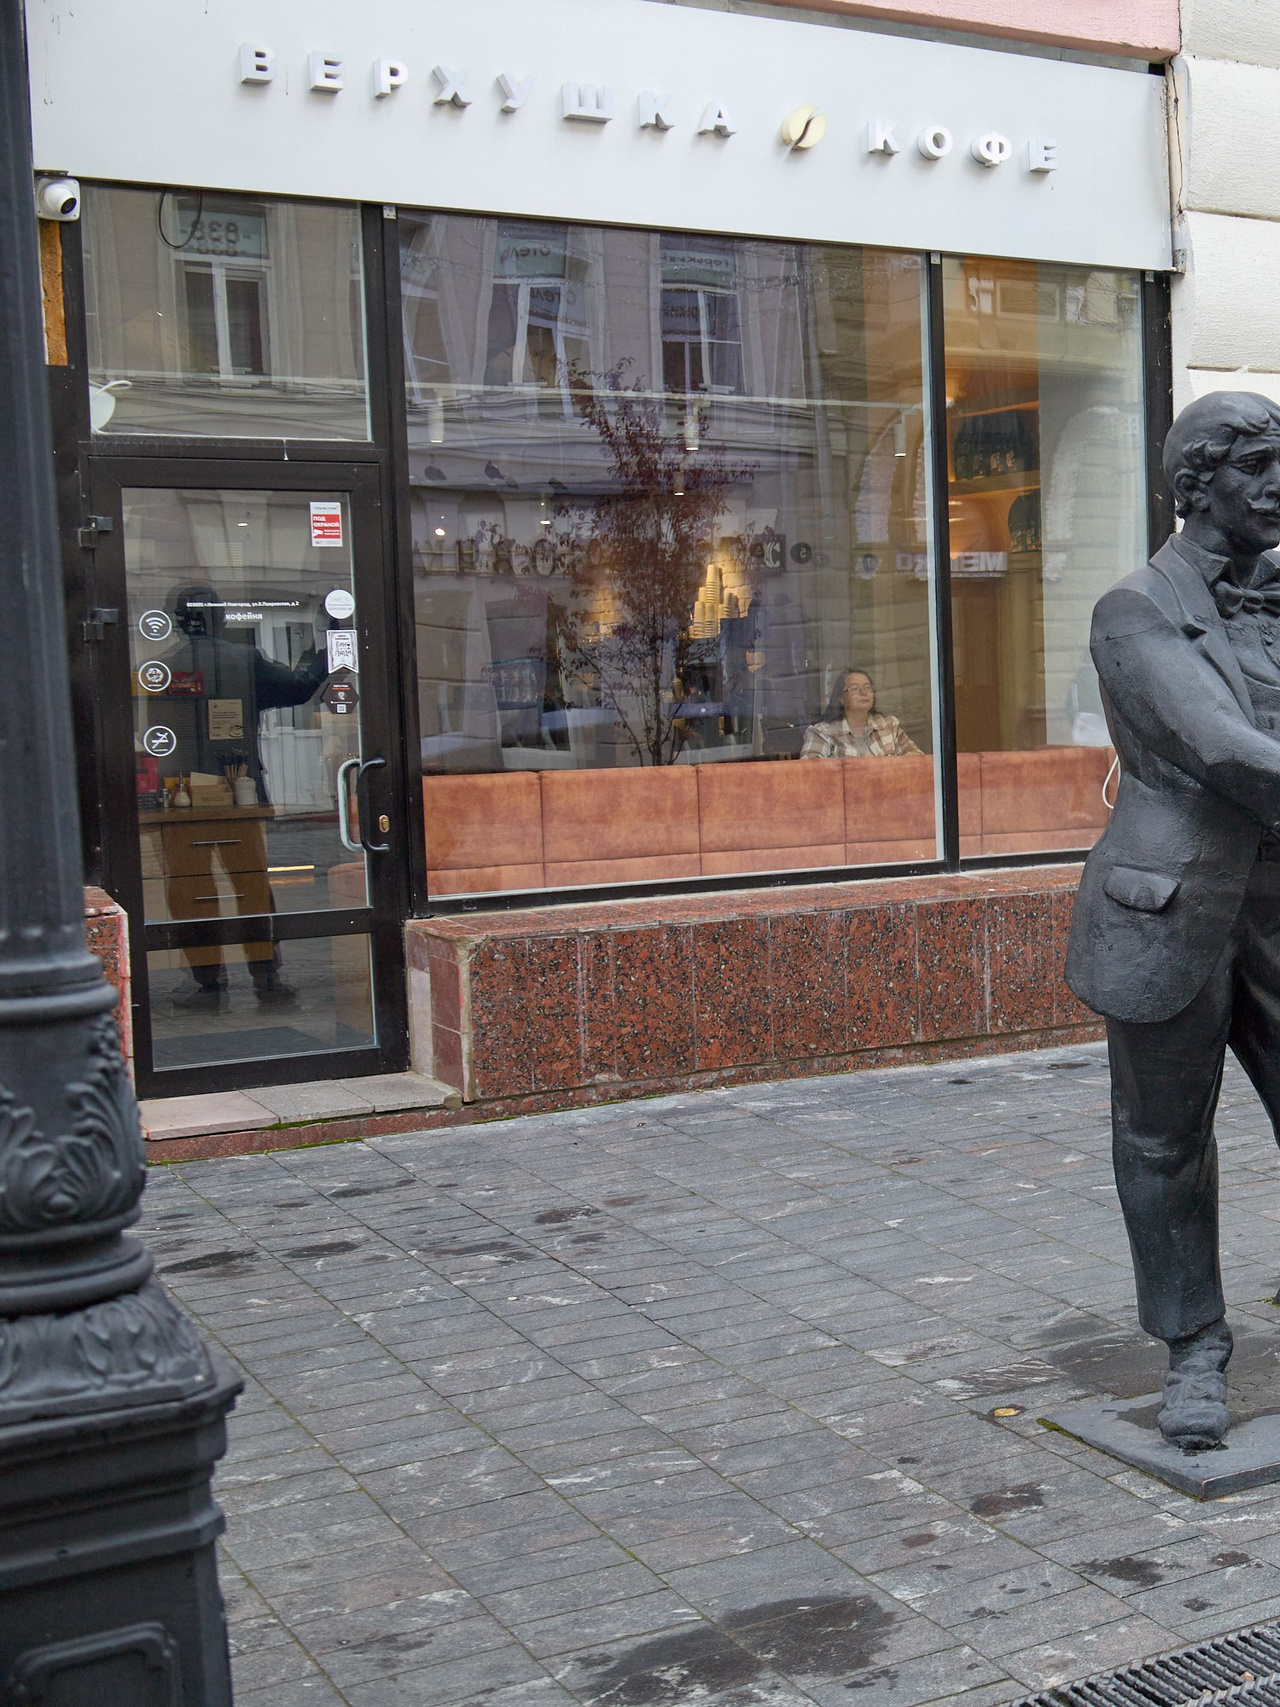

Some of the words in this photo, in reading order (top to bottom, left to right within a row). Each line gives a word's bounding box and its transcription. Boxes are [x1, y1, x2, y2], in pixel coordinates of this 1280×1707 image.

[239, 42, 737, 138] ВЕРХУШКА
[866, 117, 1059, 174] КОФЕ
[225, 611, 263, 621] кофейня
